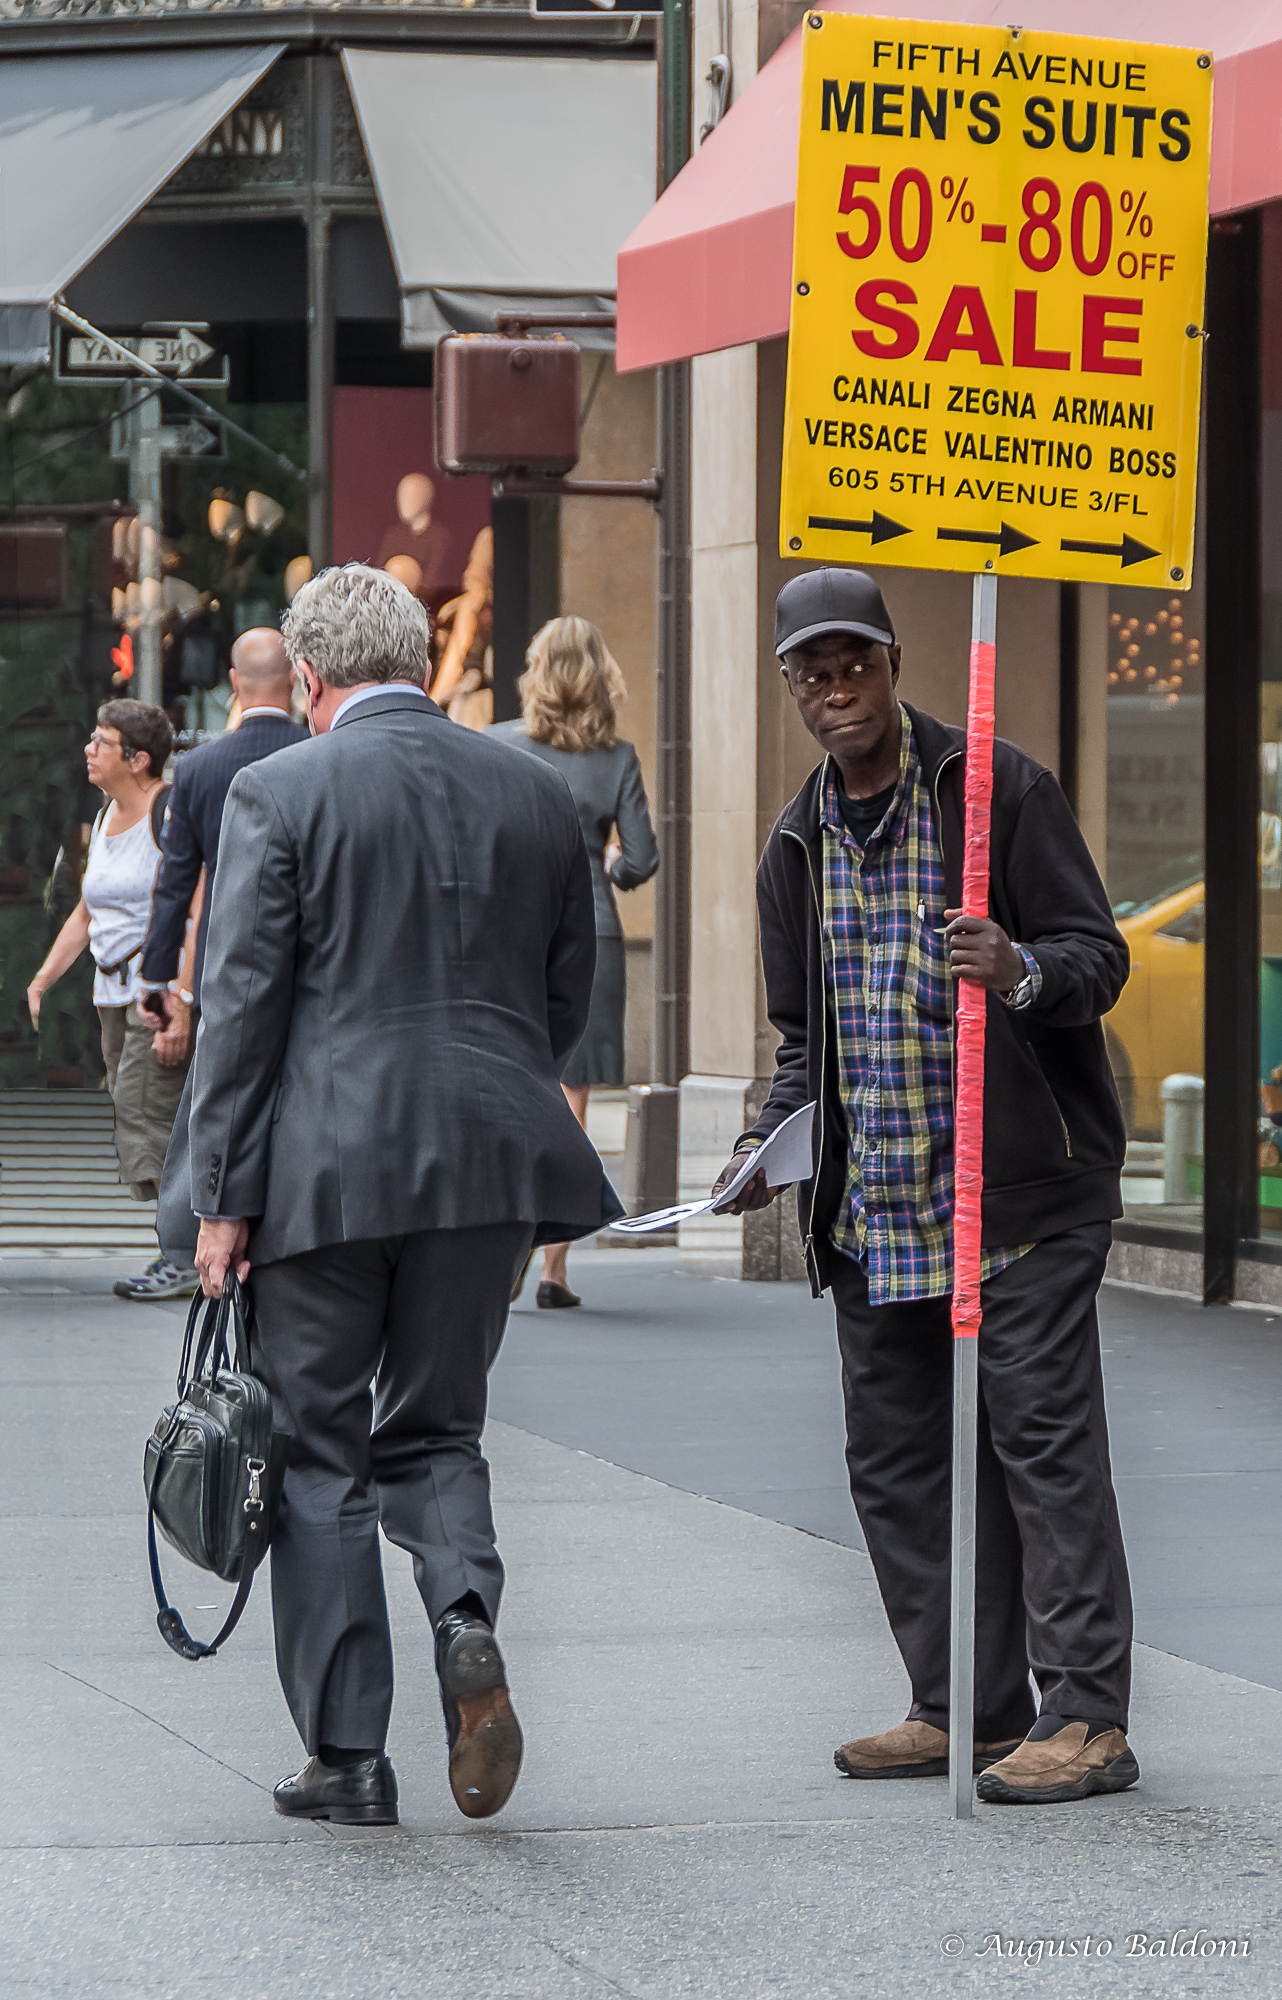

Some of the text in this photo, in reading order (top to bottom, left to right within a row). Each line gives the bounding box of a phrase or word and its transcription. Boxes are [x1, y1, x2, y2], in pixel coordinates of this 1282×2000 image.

[872, 40, 1147, 92] FIFTH AVENUE
[820, 78, 1191, 162] MEN'S SUITS
[1117, 250, 1176, 282] OFF
[851, 278, 1144, 377] SALE
[833, 375, 1154, 431] CANALI ZEGNA ARMANI
[804, 417, 1177, 479] VERSACE VALENTINO BOSS
[828, 466, 1149, 516] 605 5TH AVENUE 3/FL
